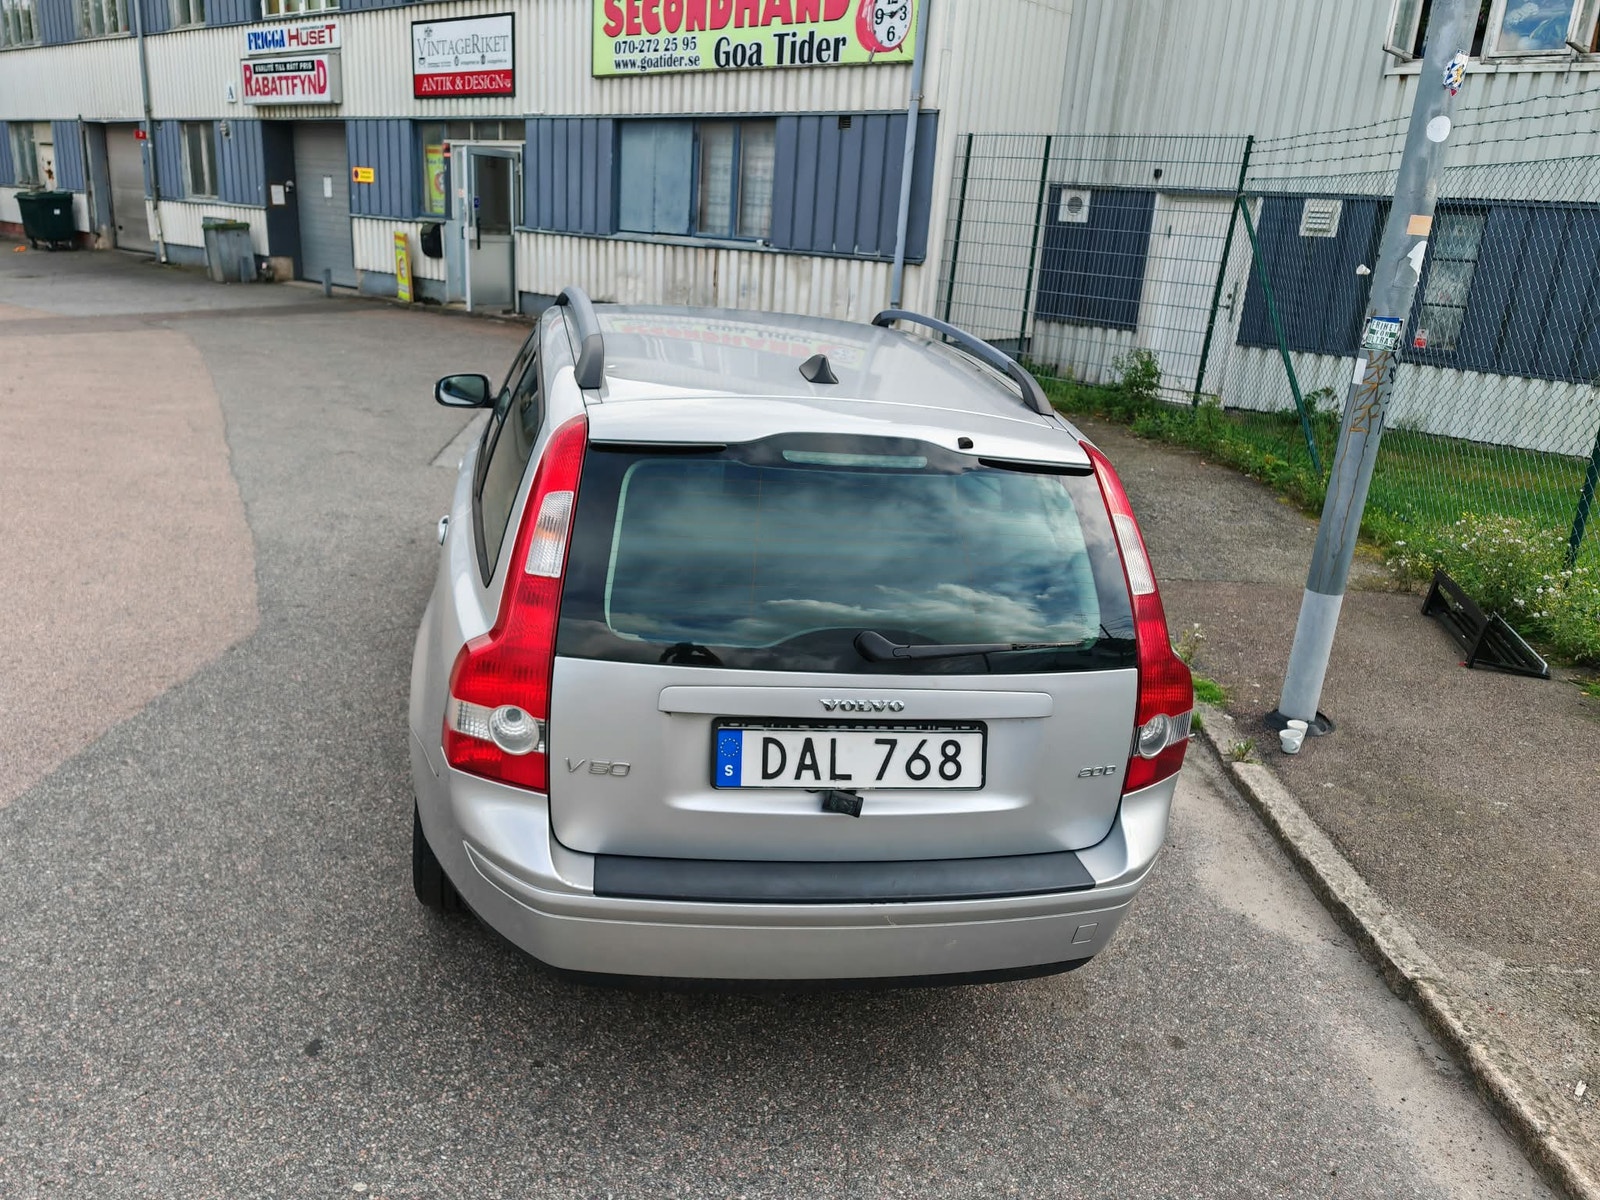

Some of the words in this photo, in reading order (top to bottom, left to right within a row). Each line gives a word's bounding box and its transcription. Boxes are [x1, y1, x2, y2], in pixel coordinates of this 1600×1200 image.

[247, 29, 286, 51] FRIGGA
[287, 24, 336, 47] HUSET
[614, 38, 660, 54] 070-272
[663, 37, 678, 53] 25
[682, 36, 697, 51] 95
[714, 36, 763, 68] Goa
[773, 30, 847, 65] Tider
[614, 53, 700, 71] www.goatider.se
[243, 59, 327, 97] RABATTFYND
[421, 76, 453, 92] ANTIK
[454, 75, 463, 91] &
[464, 73, 504, 90] DESIGN
[819, 699, 905, 713] VOLVO
[564, 757, 631, 777] V50
[724, 764, 734, 777] S
[761, 736, 852, 781] DAL
[874, 738, 962, 781] 768
